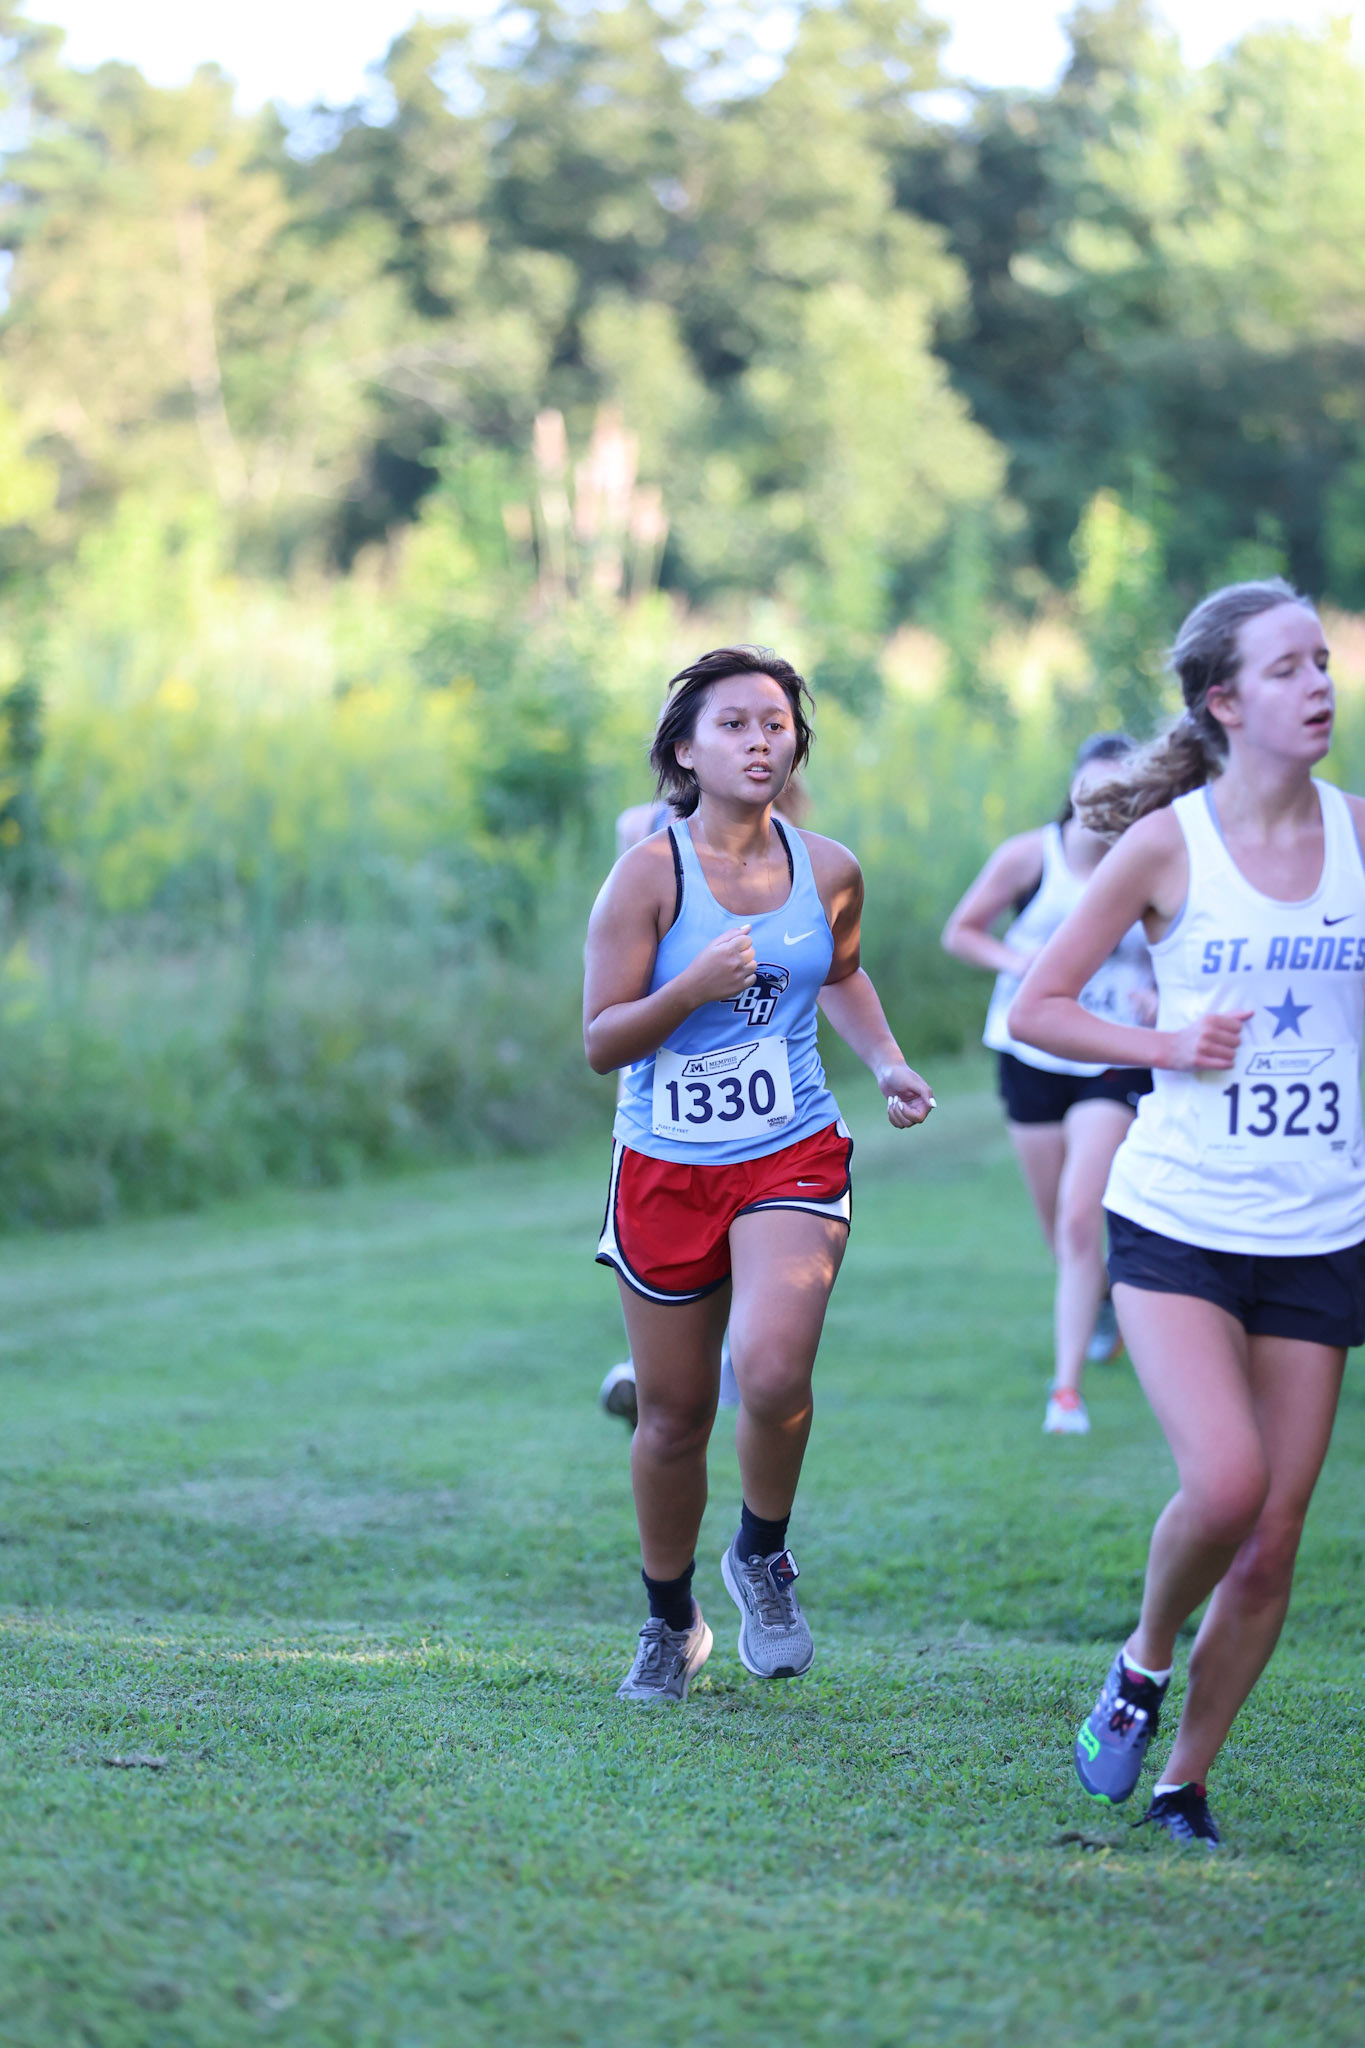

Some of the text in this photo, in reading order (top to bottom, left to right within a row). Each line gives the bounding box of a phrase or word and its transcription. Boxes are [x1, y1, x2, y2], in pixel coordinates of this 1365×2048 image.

[1201, 938, 1253, 974] ST.
[665, 1069, 776, 1124] 1330
[1223, 1081, 1340, 1137] 1323
